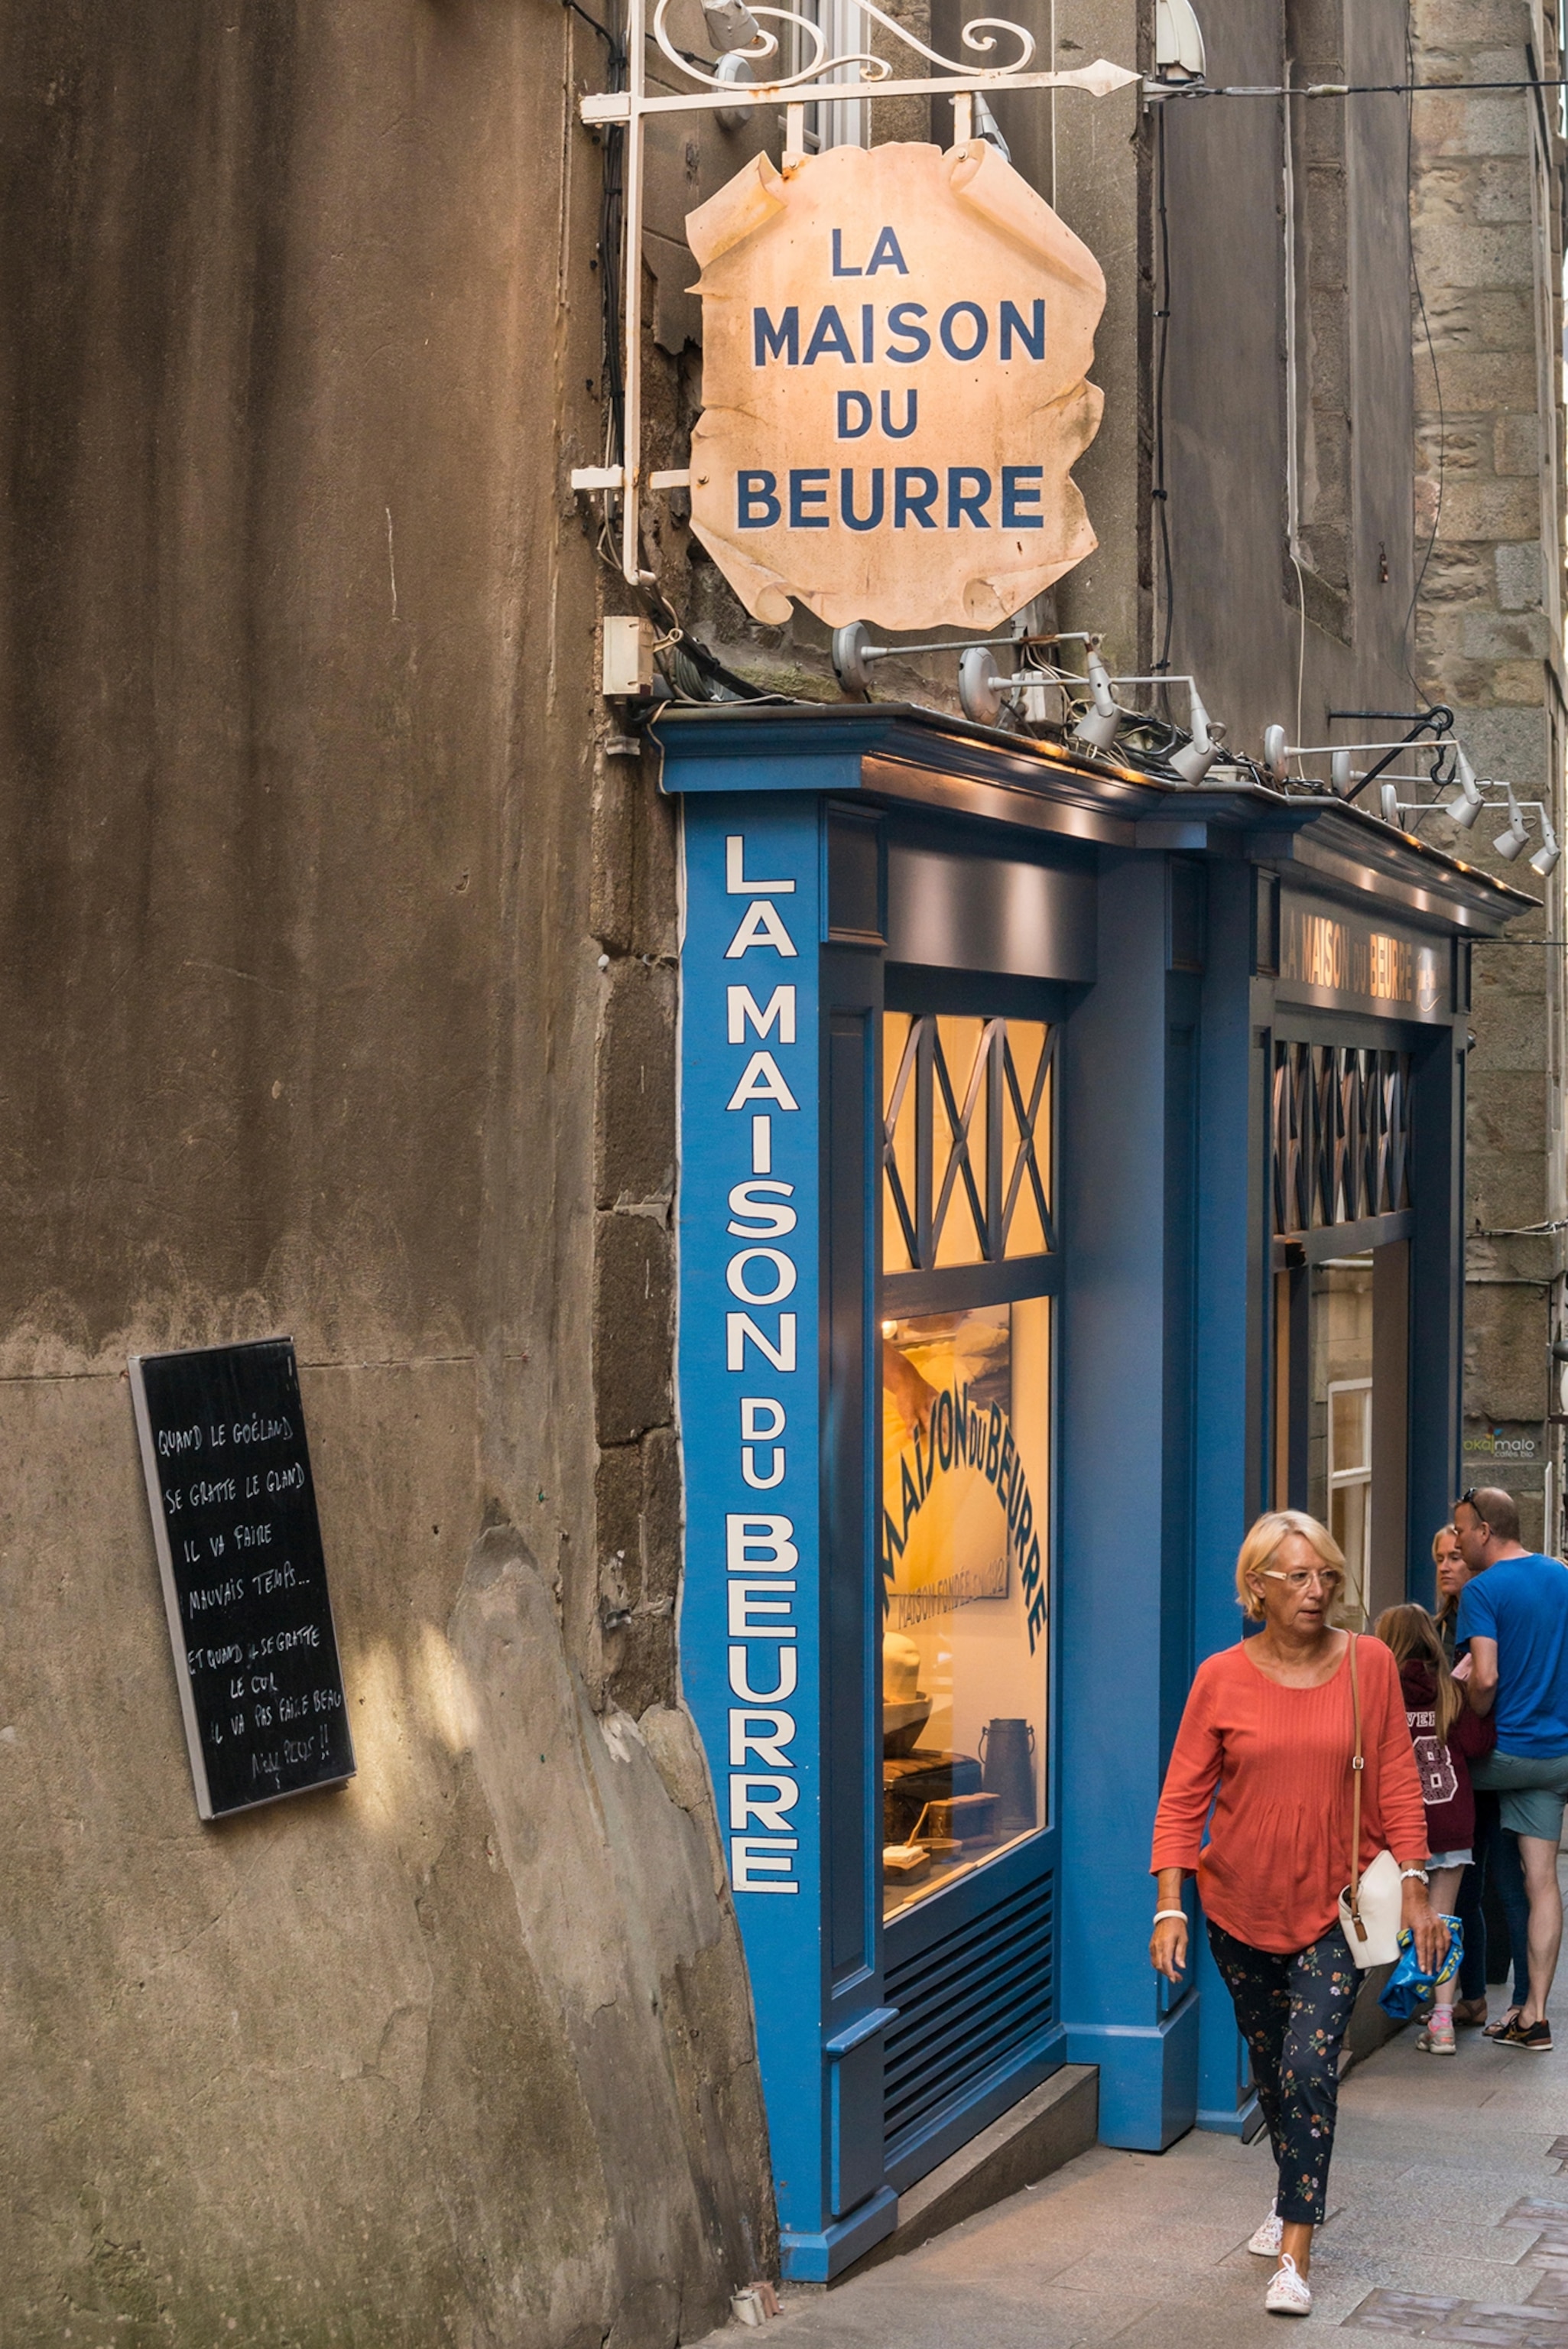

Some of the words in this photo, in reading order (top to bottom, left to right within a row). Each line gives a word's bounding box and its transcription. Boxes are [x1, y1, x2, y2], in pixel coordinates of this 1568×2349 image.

[832, 226, 910, 277] LA
[753, 299, 1046, 366] MAISON
[836, 388, 917, 439] DU
[737, 465, 1044, 531] BEURRE
[723, 834, 800, 959] LA
[1301, 913, 1350, 992] MAISON
[1369, 933, 1412, 1002] BEURRE
[724, 984, 800, 1373] MAISON
[158, 1425, 203, 1457] QUAND
[210, 1423, 227, 1447] LE
[739, 1396, 787, 1490] DU
[165, 1489, 183, 1514] SE
[190, 1478, 237, 1507] GRATTE
[246, 1474, 261, 1499] LE
[266, 1462, 306, 1492] GLAND
[183, 1540, 201, 1563] IL
[209, 1535, 226, 1558] VA
[969, 1409, 987, 1471] DU
[985, 1400, 1048, 1658] BEURRE
[898, 1581, 934, 1630] MAISON
[187, 1648, 204, 1675] ET
[206, 1643, 243, 1669] QUAND
[275, 1624, 320, 1652] GRATTE
[230, 1676, 245, 1699] LE
[250, 1672, 279, 1694] CUL
[230, 1713, 245, 1736] VA
[255, 1703, 273, 1728] PAS
[313, 1688, 342, 1713] BEAU
[725, 1512, 800, 1895] BEURRE
[1412, 1735, 1459, 1805] 8
